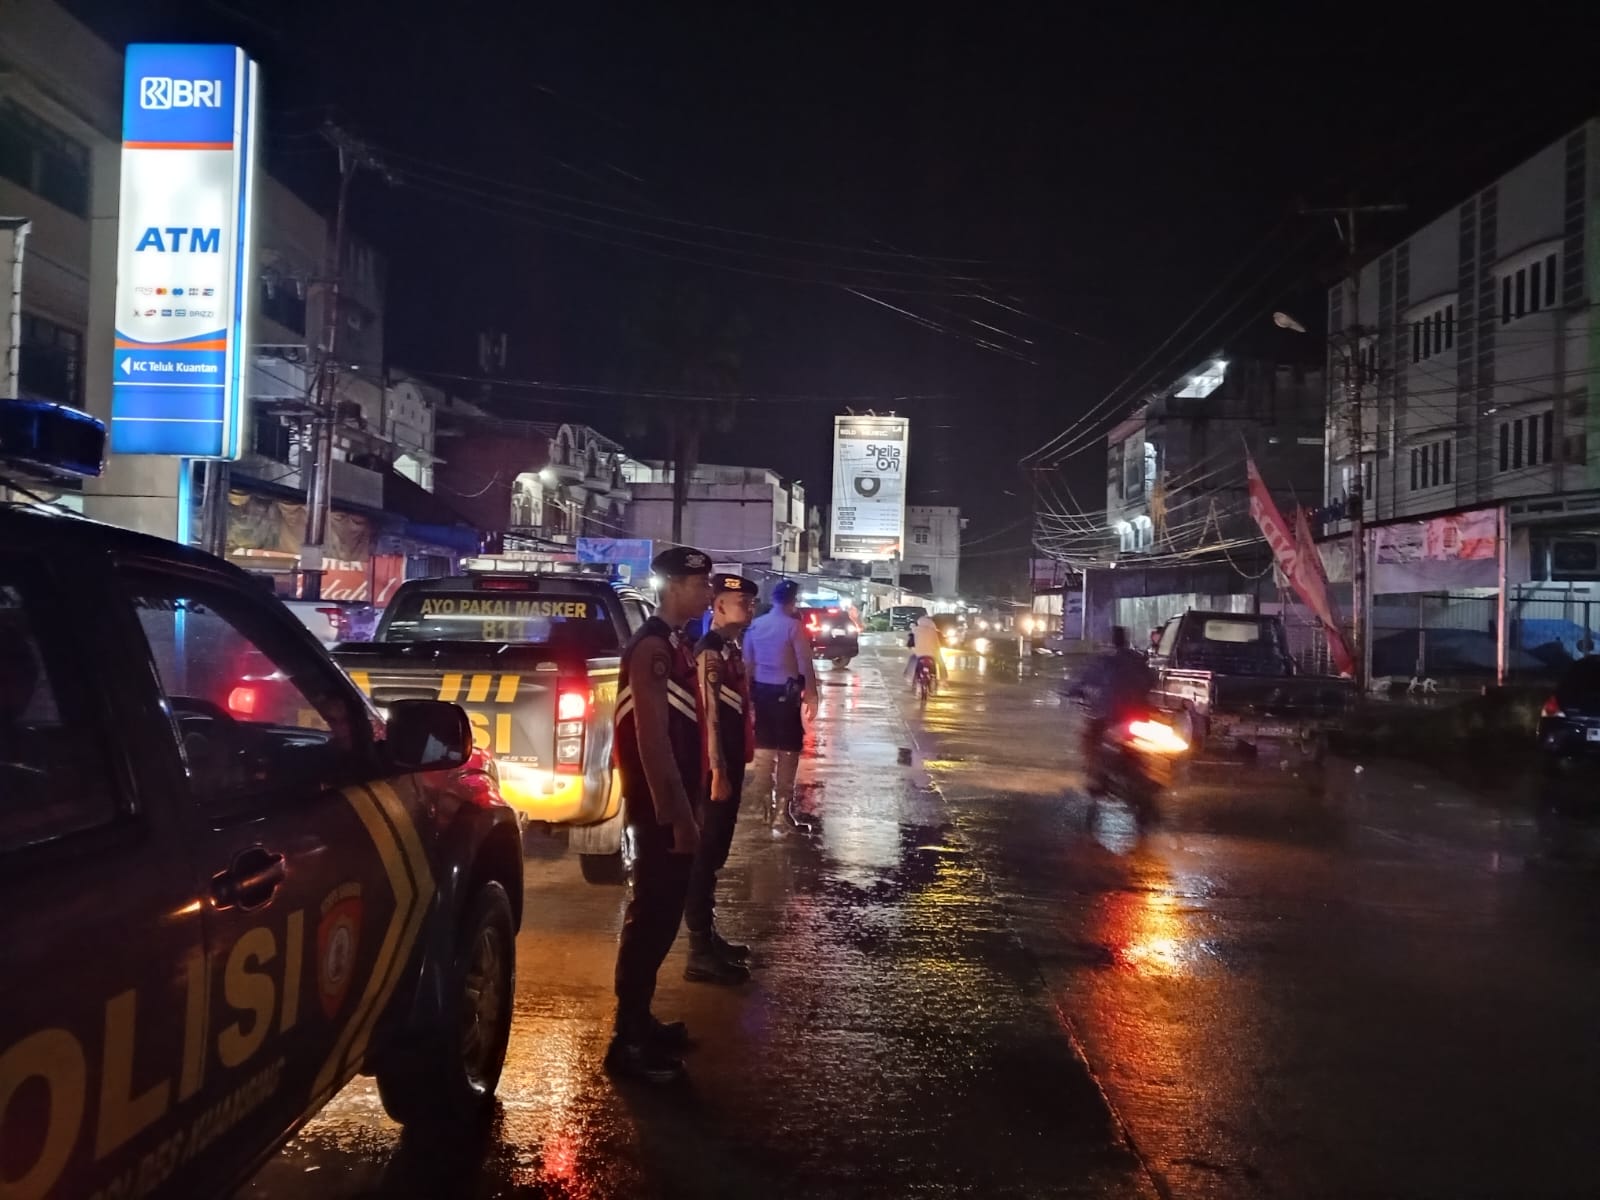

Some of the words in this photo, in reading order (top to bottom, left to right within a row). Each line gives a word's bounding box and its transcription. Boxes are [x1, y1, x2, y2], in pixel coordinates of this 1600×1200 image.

[172, 79, 222, 107] BRI
[136, 227, 220, 252] ATM
[133, 361, 147, 371] KC
[149, 361, 174, 372] Teluk
[176, 362, 218, 373] Kuantan
[866, 444, 901, 458] Sheila
[421, 598, 454, 614] AYO
[460, 599, 510, 615] PAKAI
[515, 600, 587, 618] MASKER
